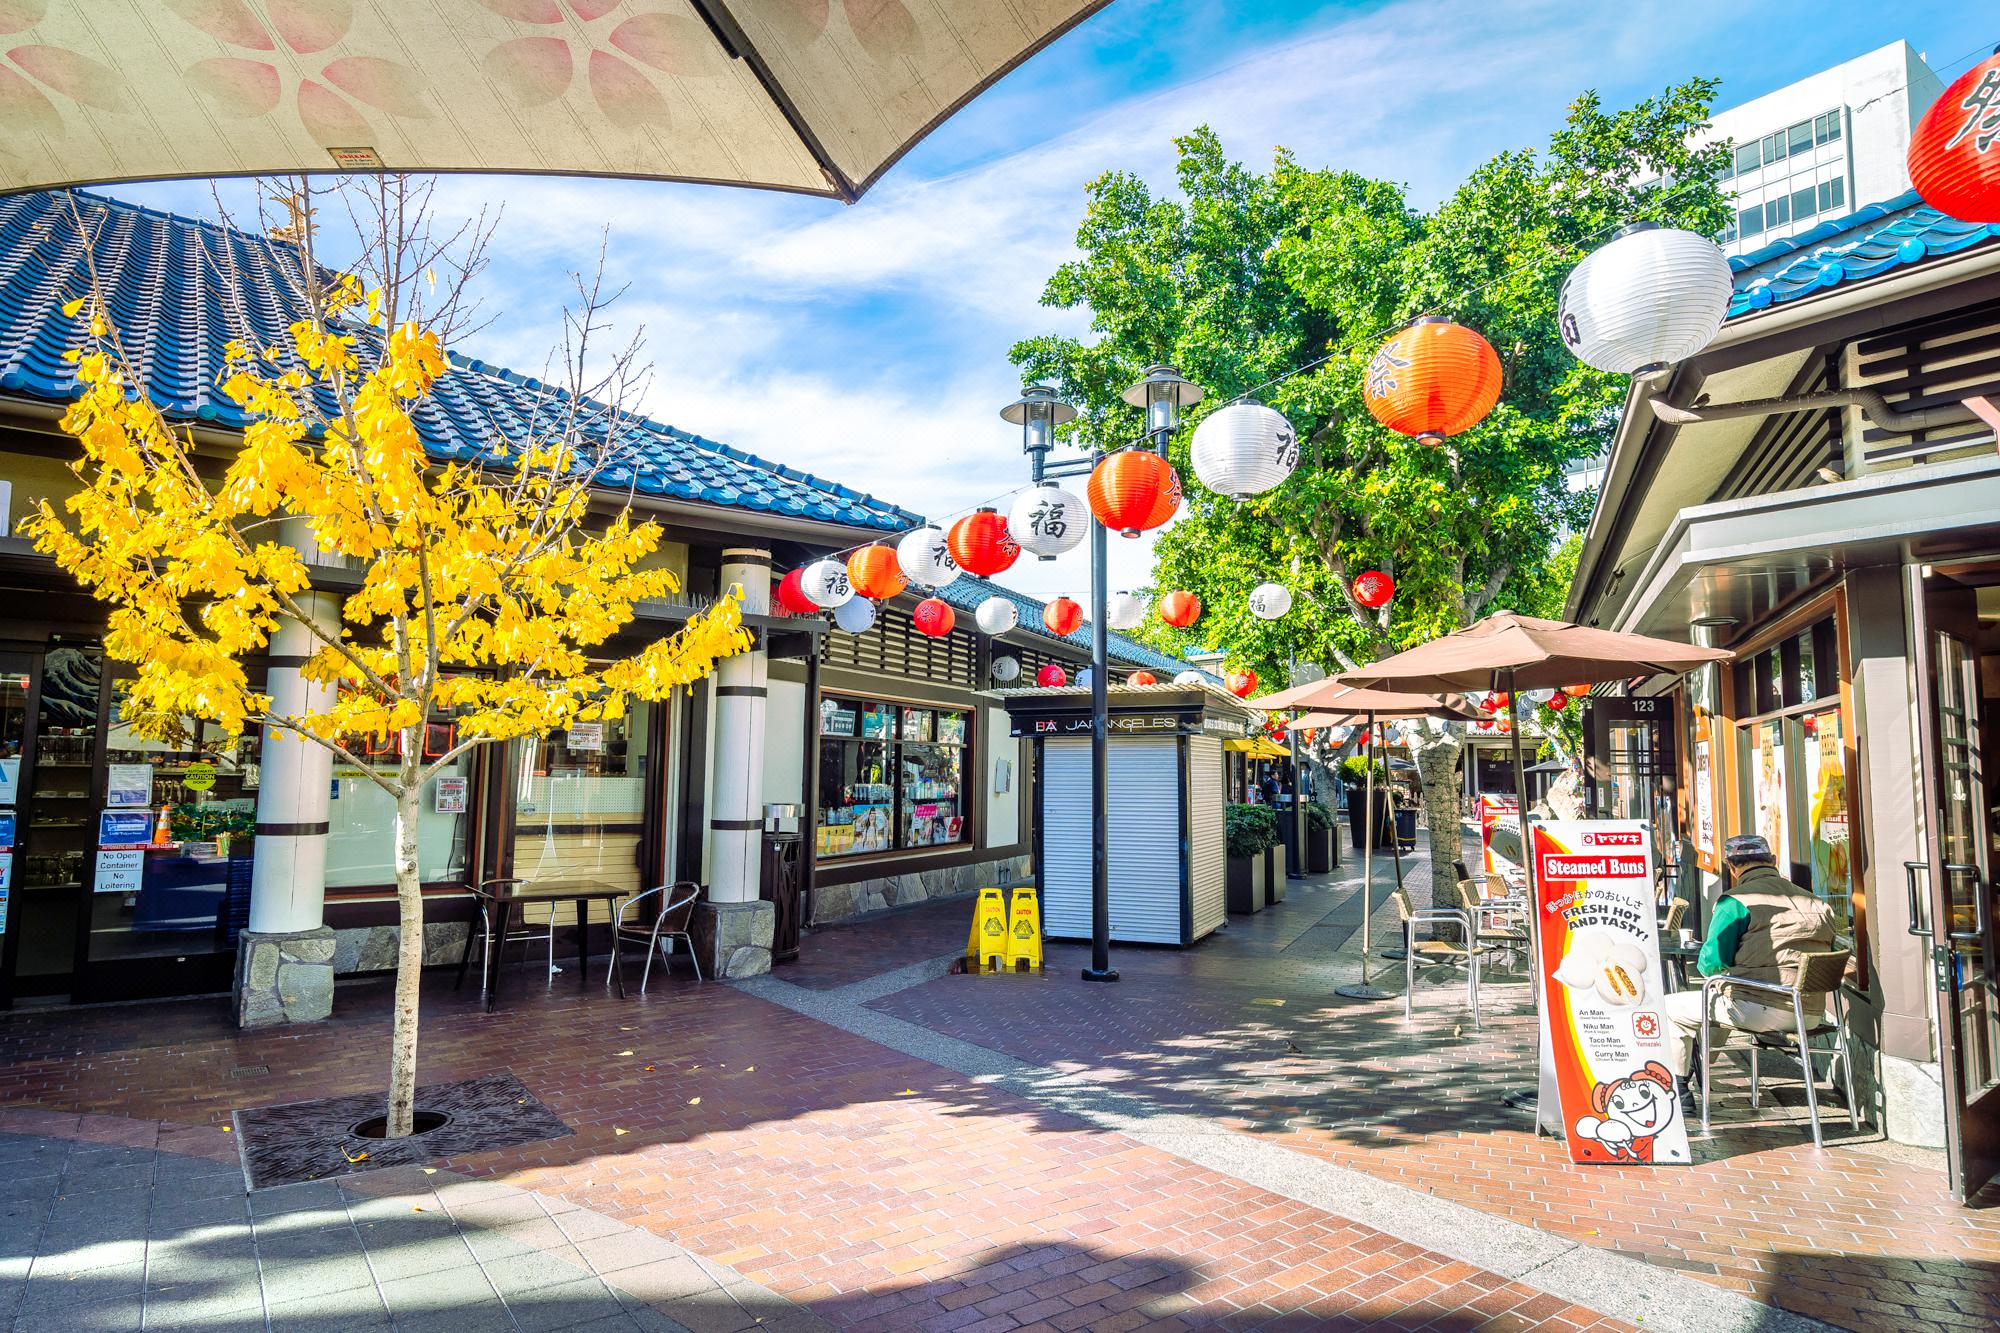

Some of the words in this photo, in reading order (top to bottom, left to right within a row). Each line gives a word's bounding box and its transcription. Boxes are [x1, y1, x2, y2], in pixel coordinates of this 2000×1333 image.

[1029, 500, 1067, 539] 福
[824, 571, 849, 596] 福
[1250, 594, 1266, 613] 福
[1632, 700, 1655, 712] 123
[1065, 718, 1176, 732] JANGELES
[1597, 834, 1640, 844] ヤマザキ
[116, 852, 137, 860] Open
[1548, 859, 1606, 875] Steamed
[1609, 858, 1644, 874] Buns
[1546, 890, 1643, 913] ほっかほかのおいしさ
[1562, 904, 1608, 920] FRESH
[1612, 906, 1641, 922] HOT
[1568, 916, 1598, 931] AND
[1600, 916, 1649, 942] TASTY!
